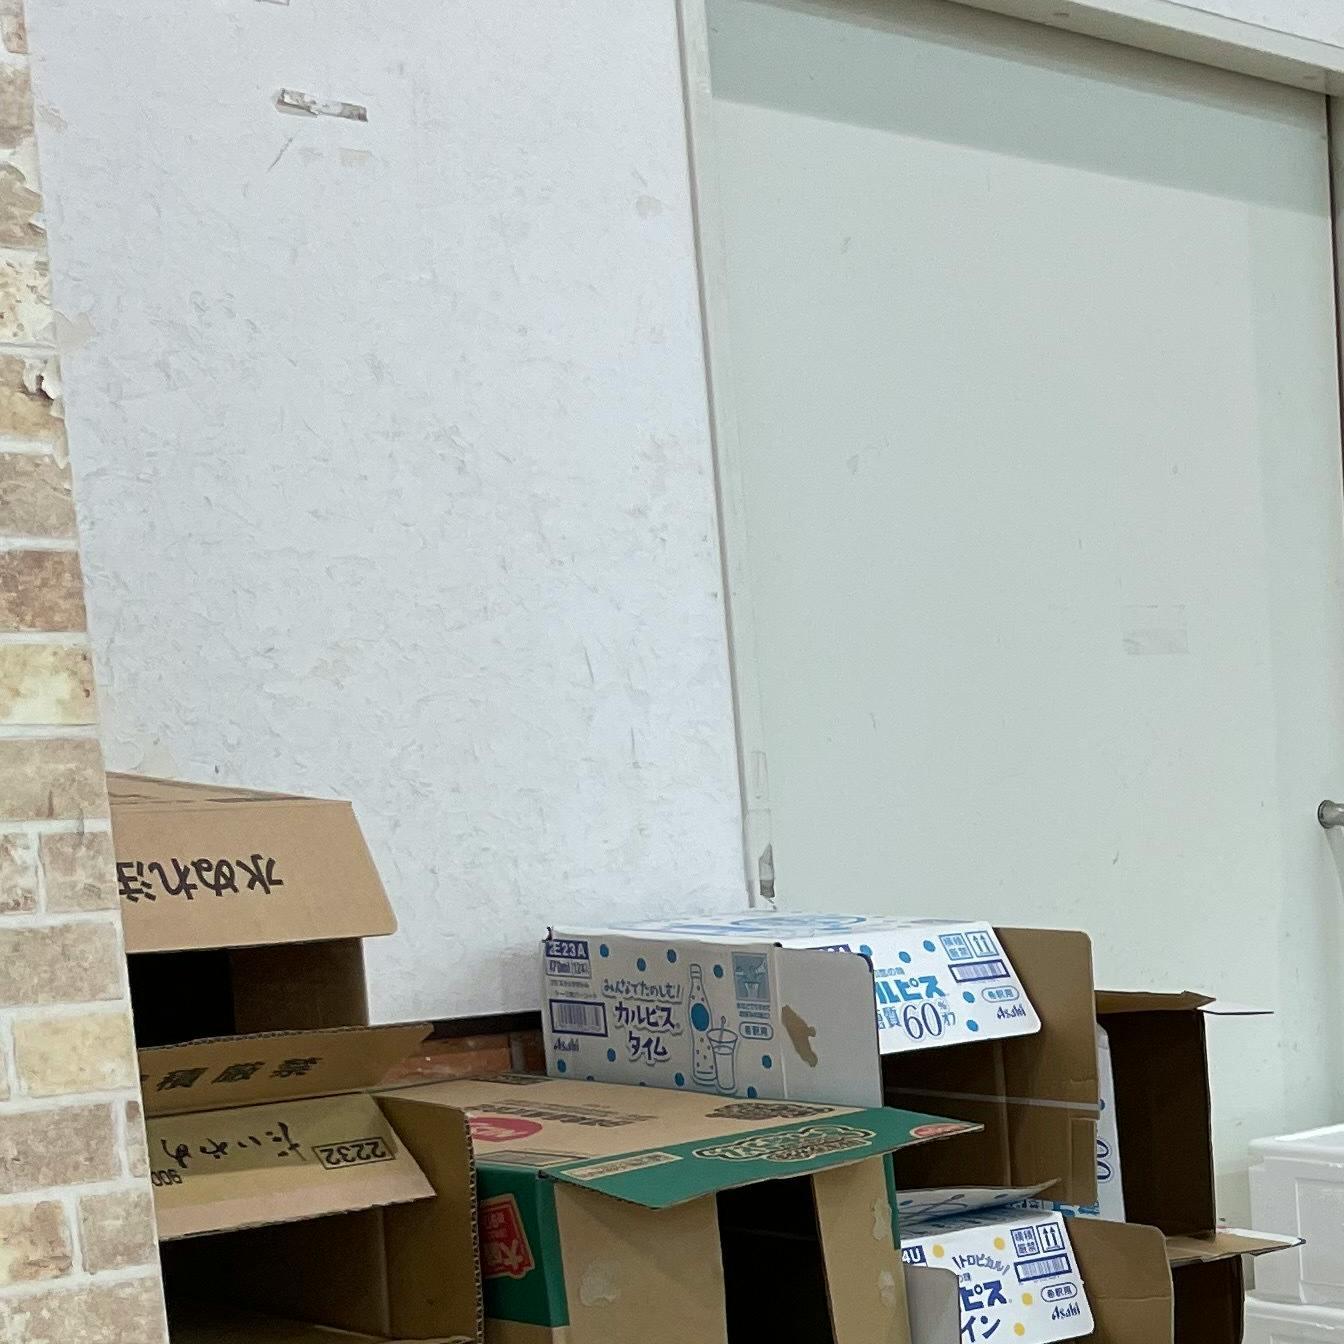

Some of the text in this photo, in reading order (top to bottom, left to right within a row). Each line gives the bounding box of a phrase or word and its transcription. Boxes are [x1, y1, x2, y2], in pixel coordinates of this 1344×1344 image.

[615, 1001, 675, 1029] カルピス
[996, 1004, 1027, 1019] Asahi
[629, 1031, 668, 1060] タイム
[161, 1121, 307, 1170] だいやめ
[321, 1138, 387, 1166] 2232
[957, 1253, 1006, 1275] トロピカル
[1051, 1301, 1081, 1321] Asahi
[961, 1315, 1001, 1343] イン
